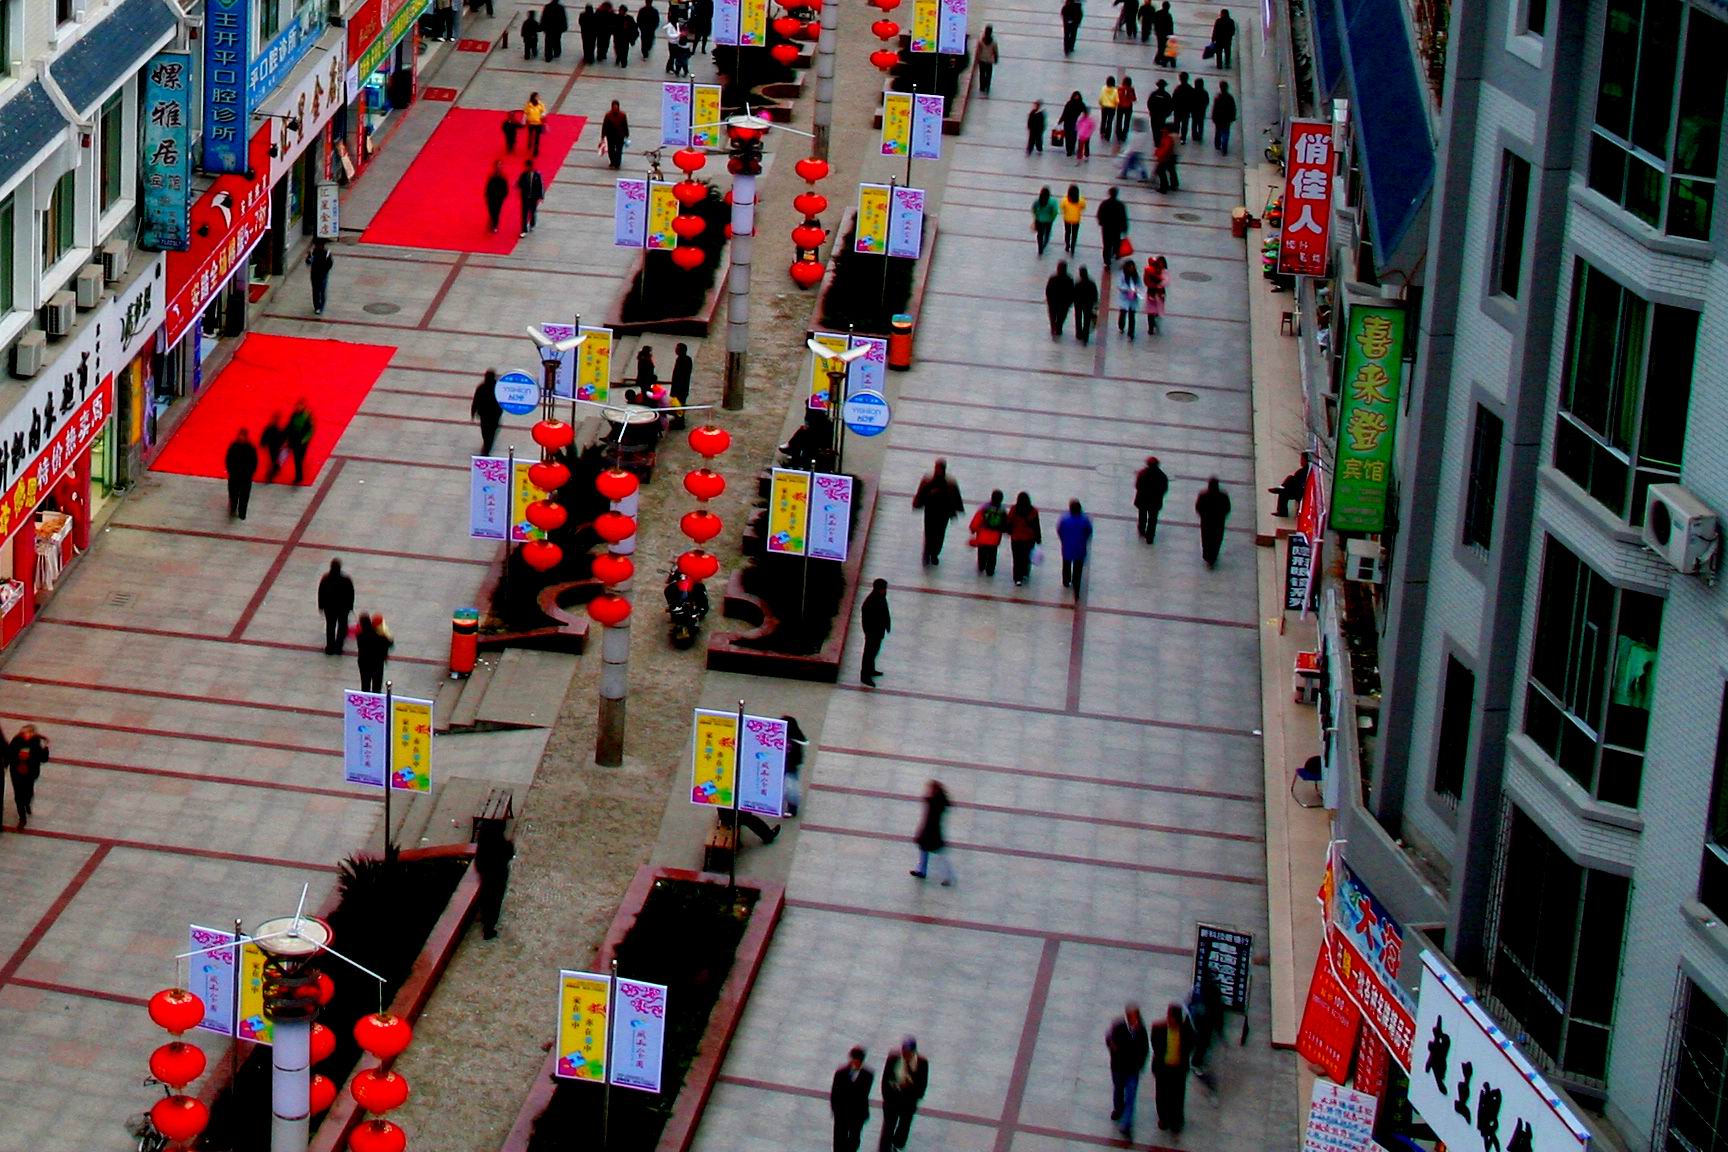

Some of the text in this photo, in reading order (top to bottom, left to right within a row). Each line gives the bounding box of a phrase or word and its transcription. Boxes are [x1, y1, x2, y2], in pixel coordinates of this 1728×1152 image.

[212, 12, 239, 143] 王开平口腔诊所
[1287, 132, 1331, 235] 俏佳人
[1348, 315, 1393, 452] 喜来登
[1342, 457, 1386, 484] 宾馆
